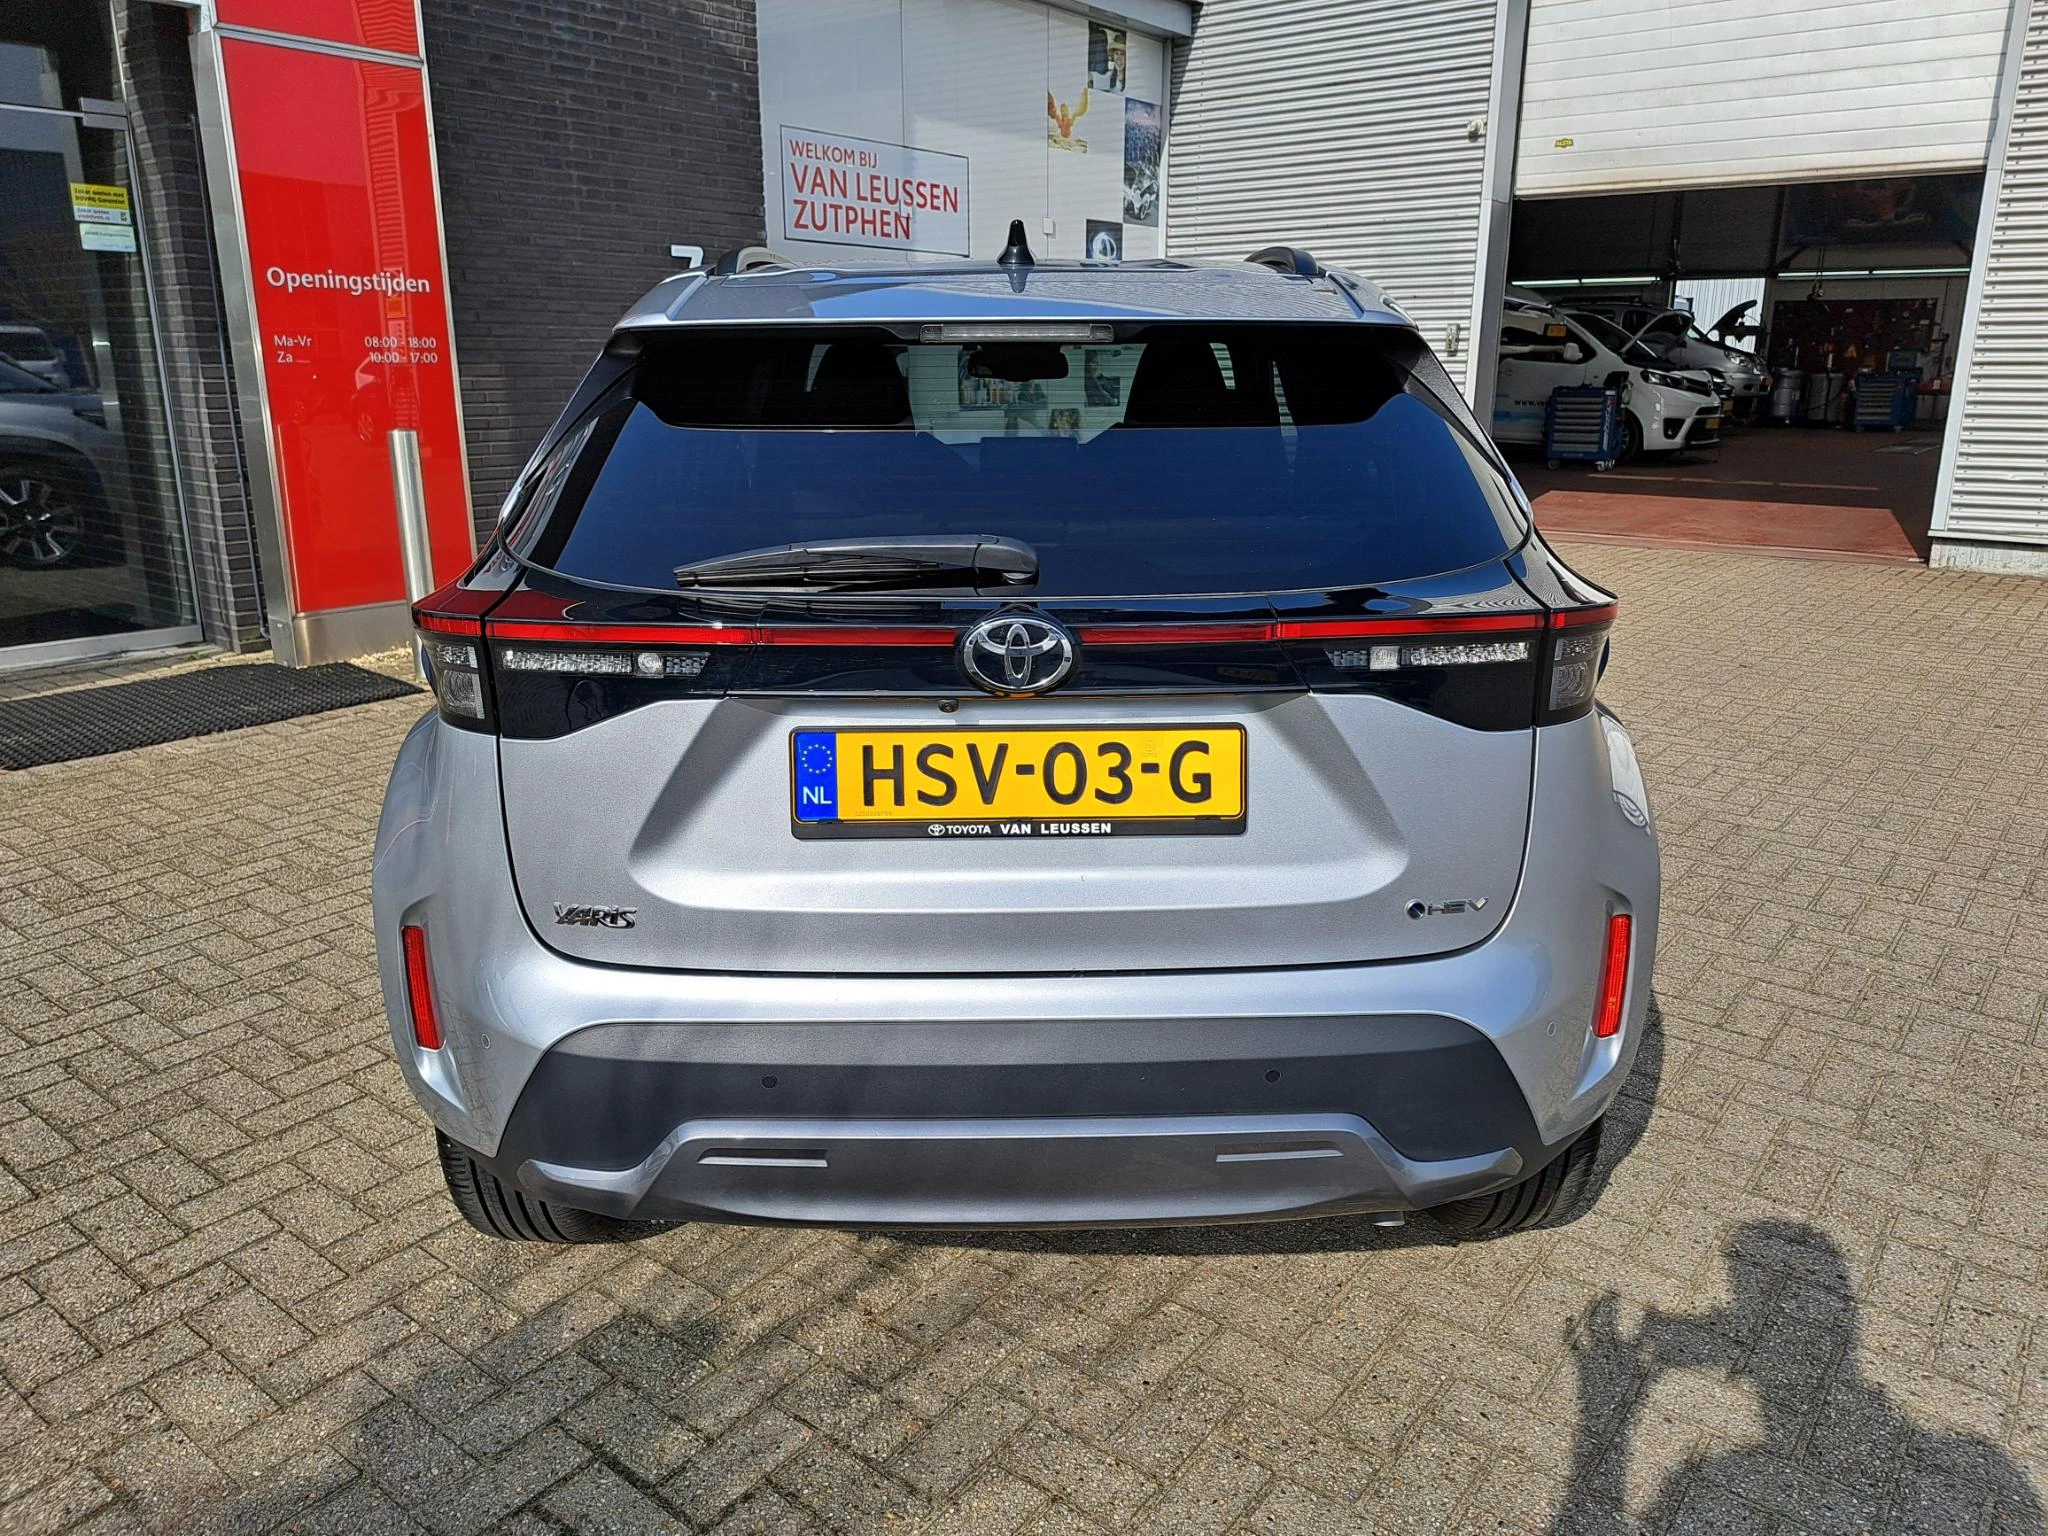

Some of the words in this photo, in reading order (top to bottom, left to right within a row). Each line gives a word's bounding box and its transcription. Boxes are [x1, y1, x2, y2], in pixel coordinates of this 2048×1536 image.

[789, 139, 856, 166] WELKOM
[859, 151, 878, 169] BIJ
[790, 162, 848, 199] VAN
[856, 172, 959, 214] LEUSSEN
[793, 198, 911, 240] ZUTPHEN
[266, 266, 431, 296] Openingstijden
[274, 335, 313, 348] Ma-Vr
[364, 336, 398, 348] 08:00
[408, 337, 437, 349] 18:00
[277, 351, 294, 363] Za
[370, 352, 400, 363] 10:00
[410, 352, 438, 364] 17:00
[862, 739, 1213, 807] HSV-03-G
[802, 785, 833, 805] NL
[946, 824, 992, 835] TOYOTA
[1000, 823, 1032, 835] VAN
[1040, 822, 1112, 834] LEUSSEN
[1427, 896, 1489, 915] HEV
